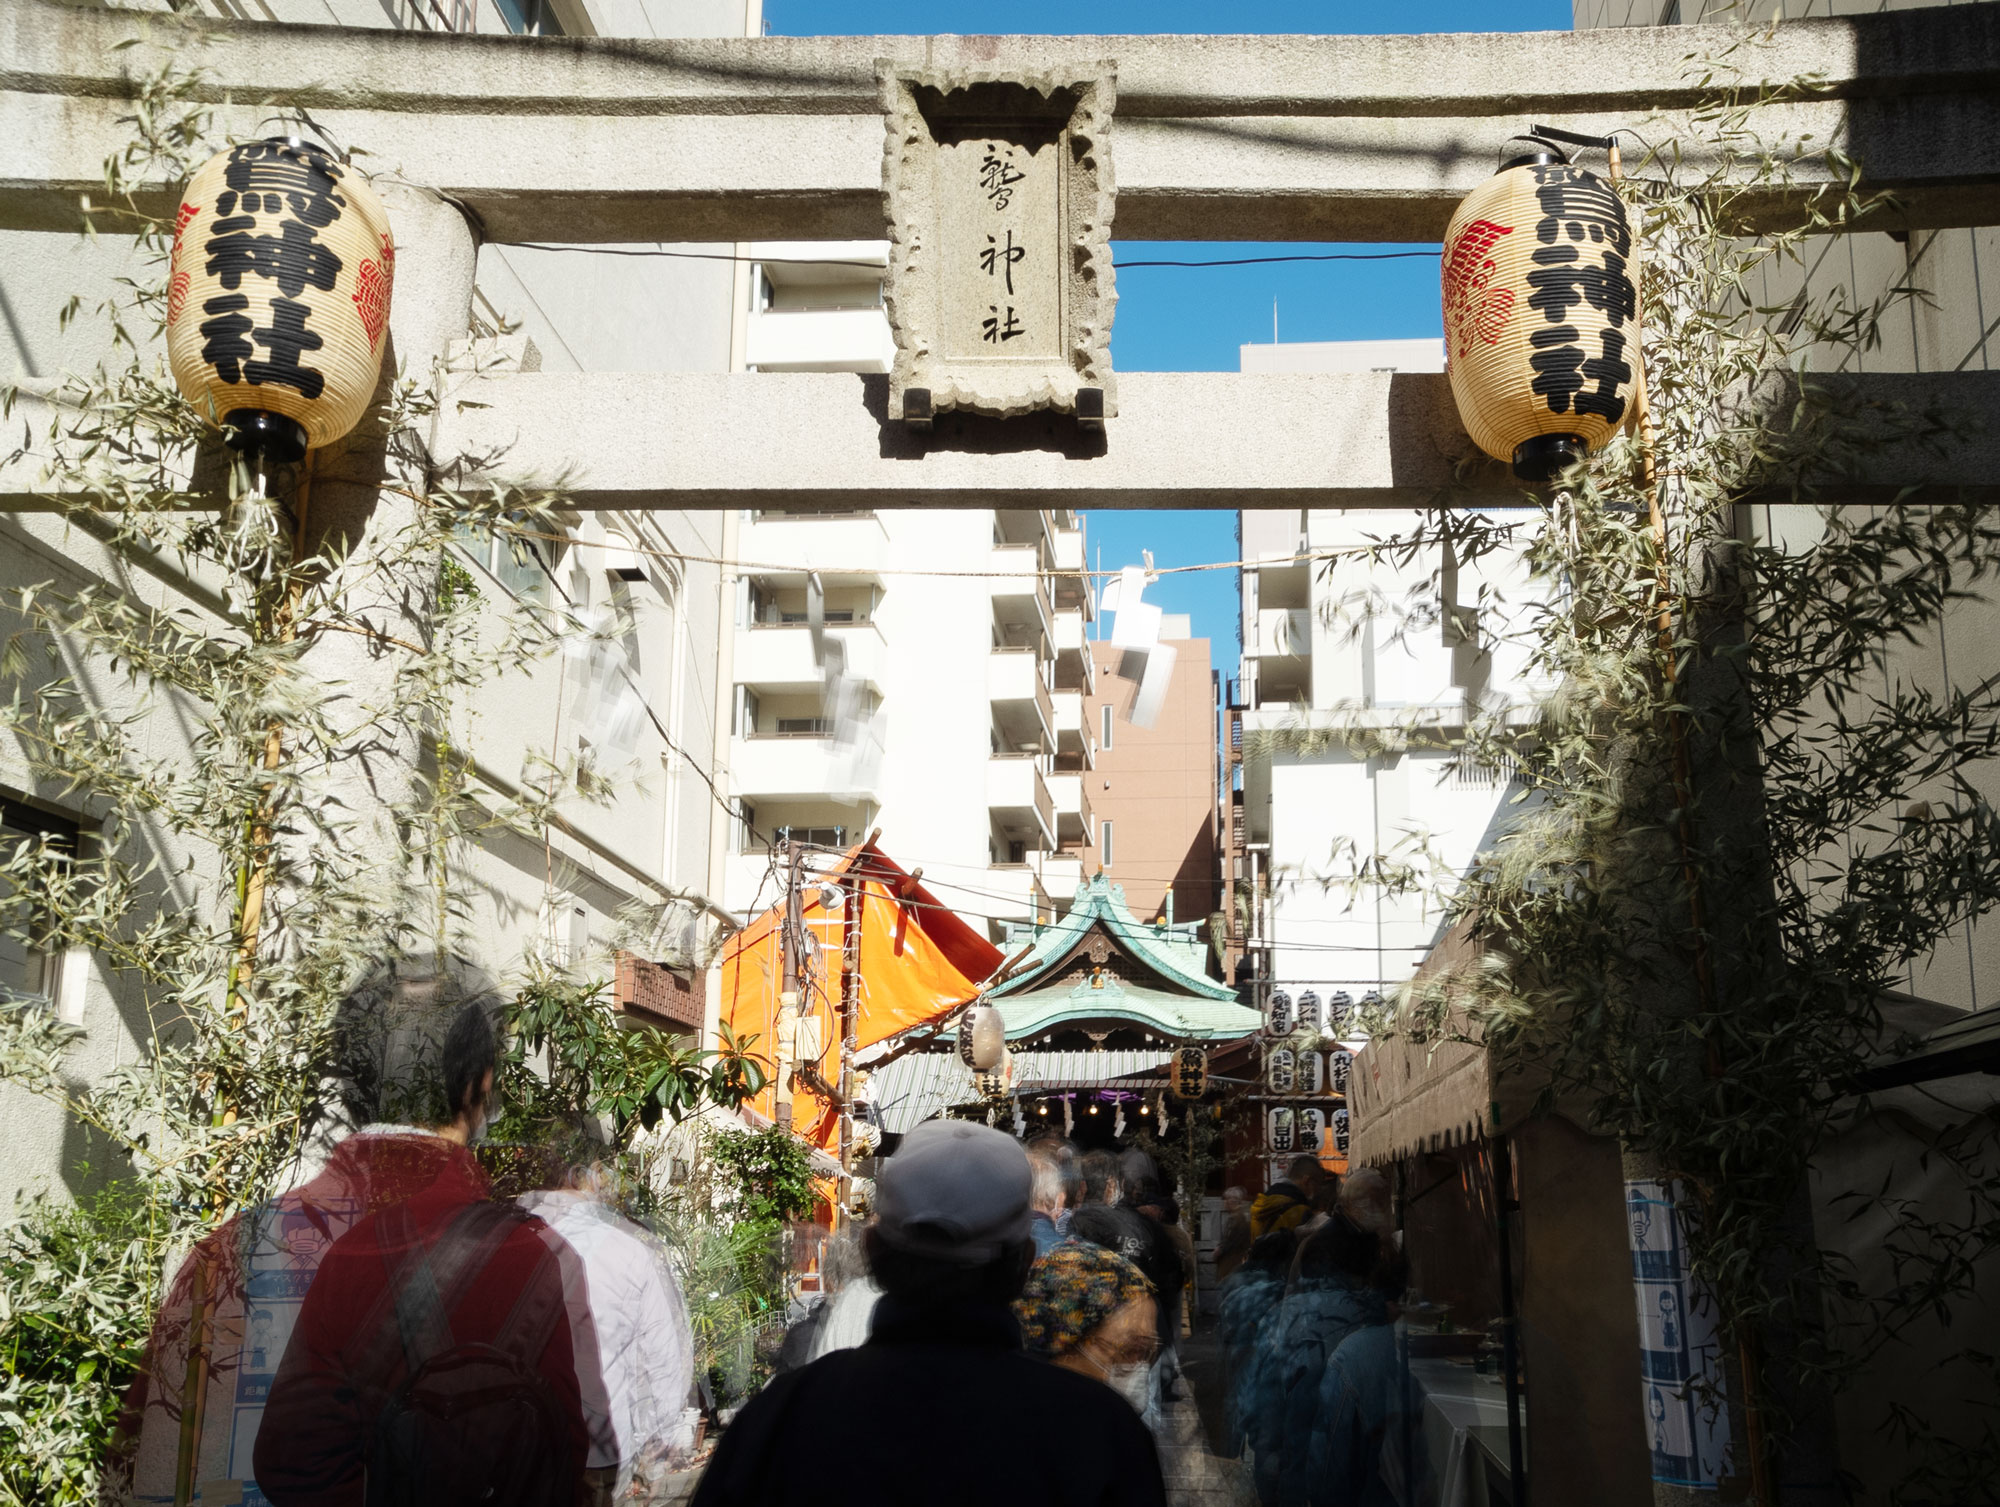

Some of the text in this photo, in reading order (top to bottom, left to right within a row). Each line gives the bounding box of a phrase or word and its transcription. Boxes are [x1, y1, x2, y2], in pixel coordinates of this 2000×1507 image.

[199, 144, 347, 400] 鷲神社
[979, 143, 1026, 345] 鷲神社
[1526, 164, 1637, 424] 鷲神社
